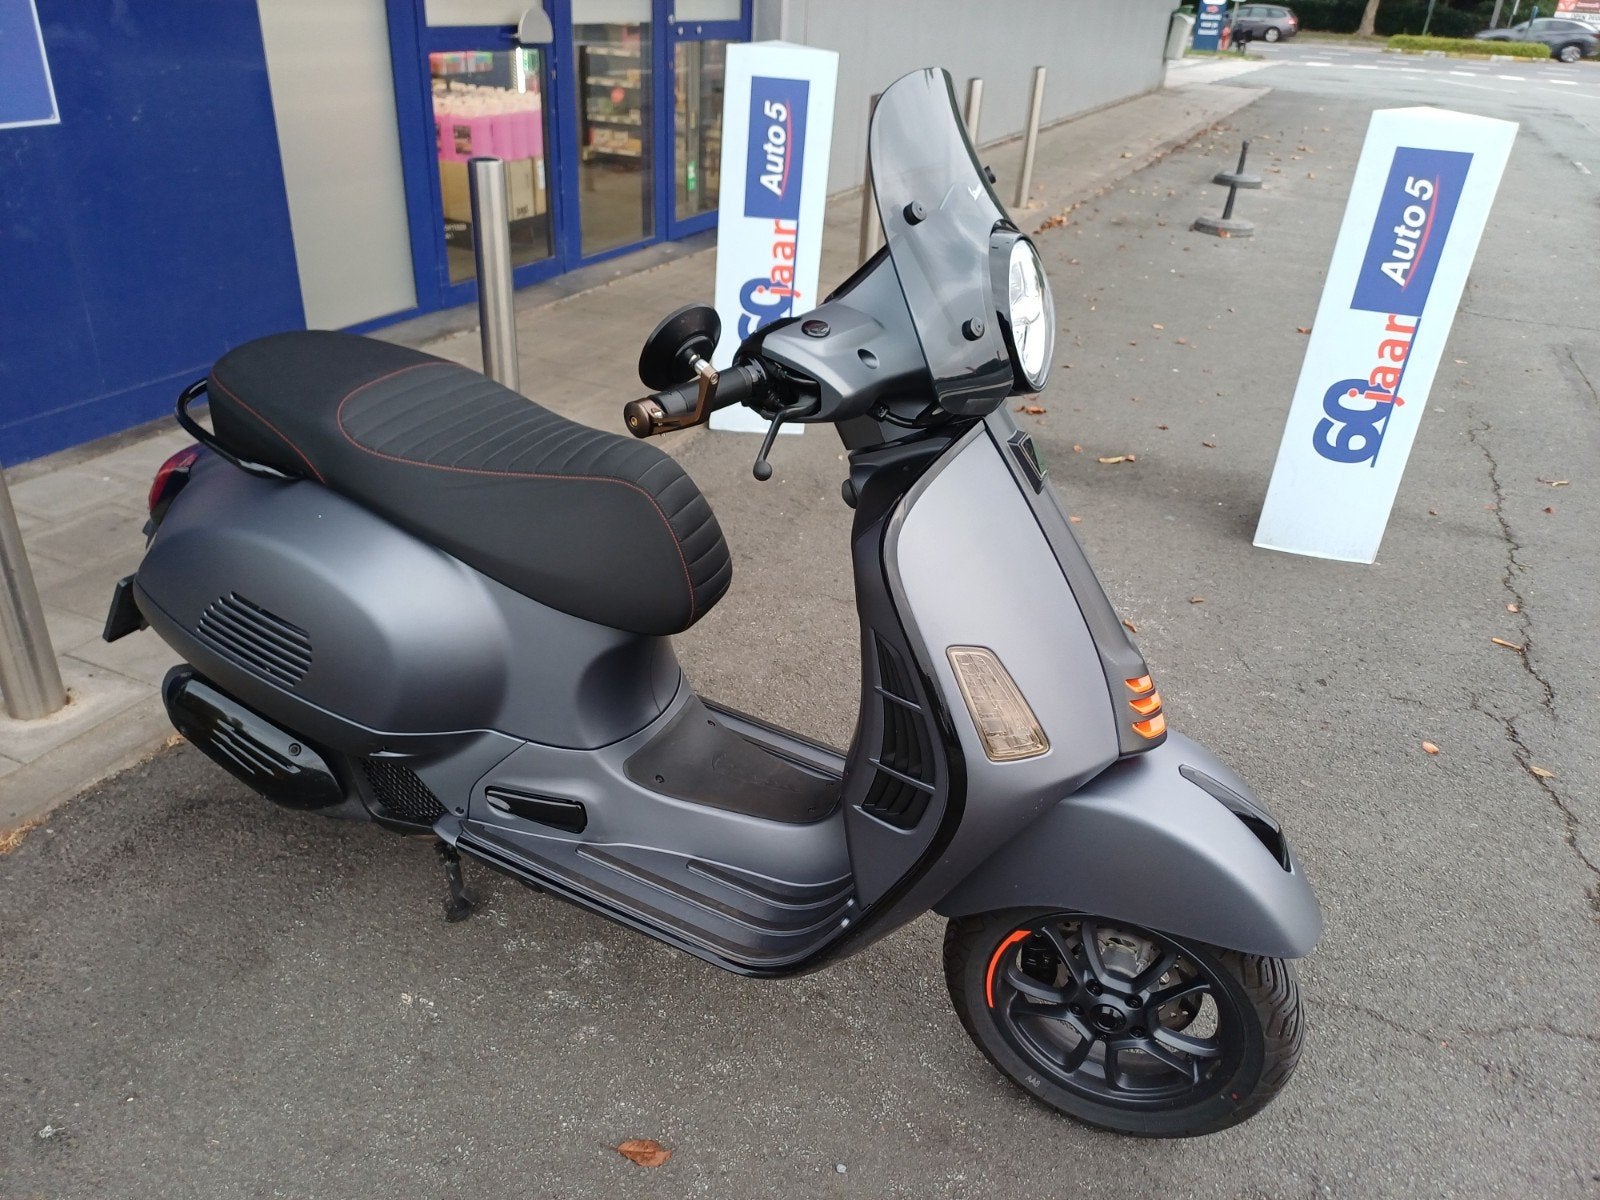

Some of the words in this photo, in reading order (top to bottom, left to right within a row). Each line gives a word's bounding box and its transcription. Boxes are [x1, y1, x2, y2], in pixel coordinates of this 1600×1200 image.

[764, 100, 788, 122] 5
[760, 125, 787, 196] Auto
[757, 218, 802, 298] jaar
[1381, 205, 1426, 287] Auto
[1404, 176, 1434, 201] 5
[1348, 314, 1416, 407] jaar
[1313, 379, 1394, 463] 60
